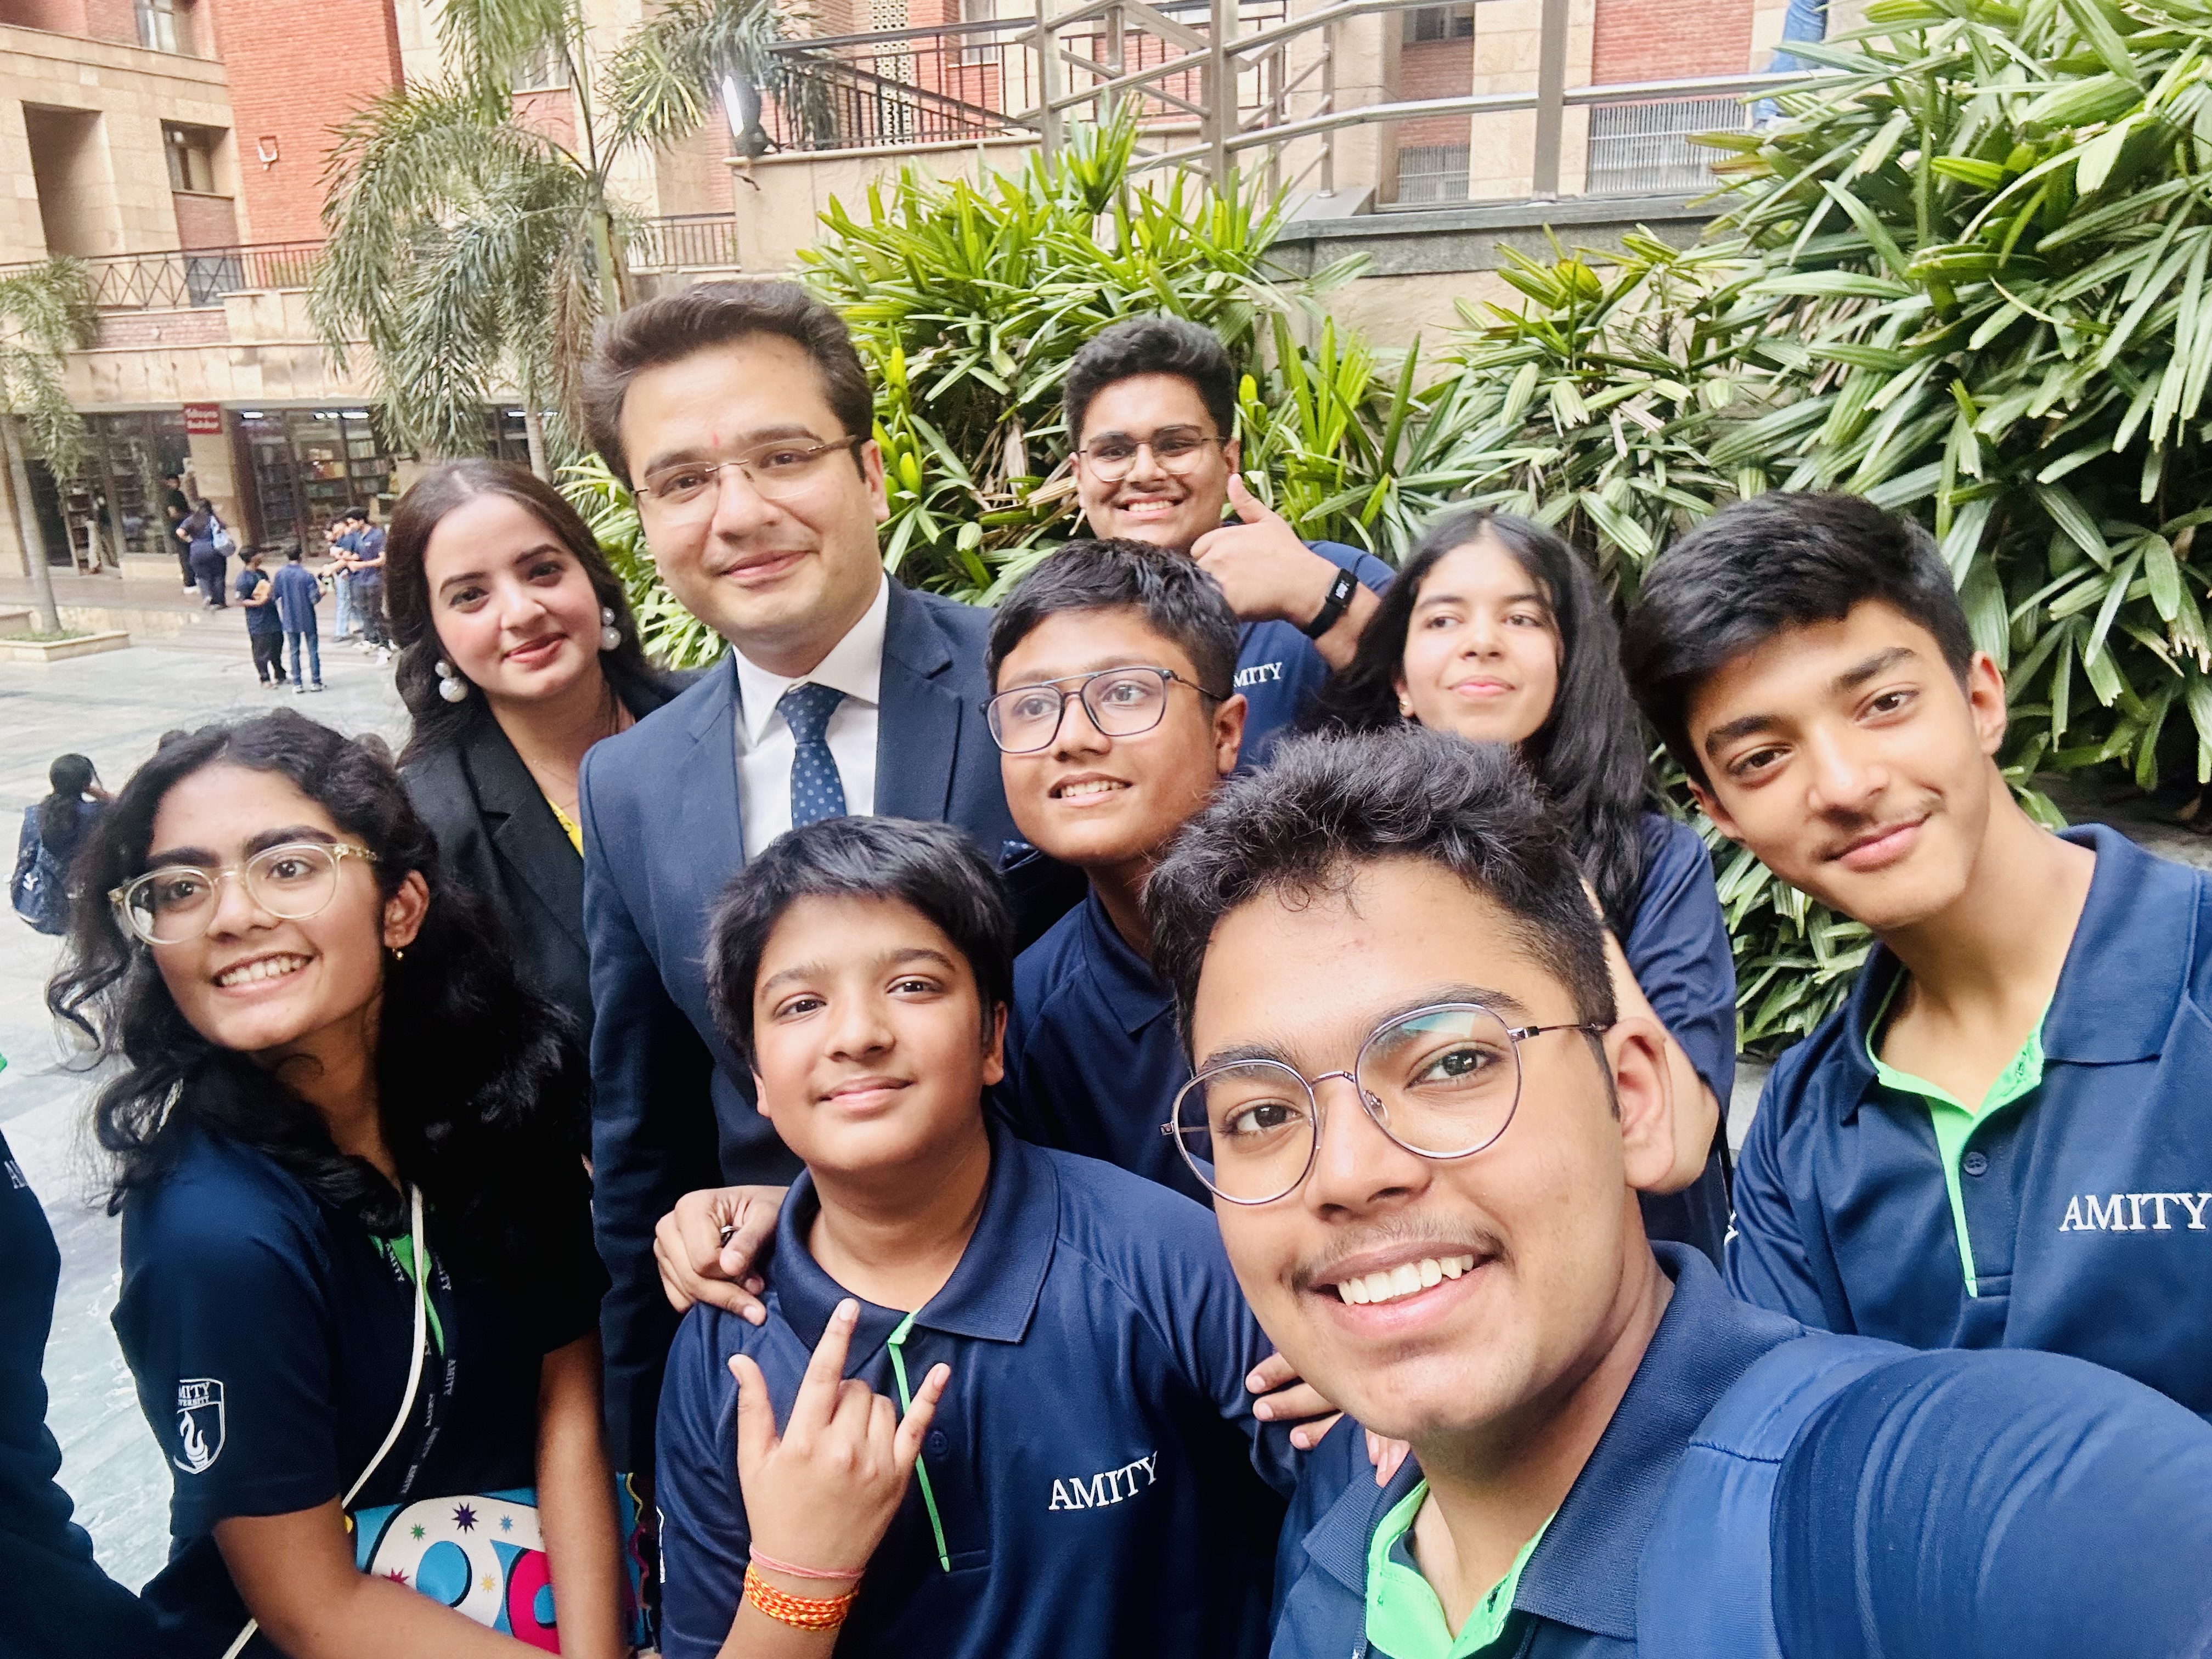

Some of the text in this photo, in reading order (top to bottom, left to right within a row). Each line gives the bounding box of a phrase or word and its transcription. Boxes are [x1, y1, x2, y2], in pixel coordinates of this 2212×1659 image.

[1233, 662, 1283, 688] MITY
[2058, 1192, 2212, 1232] AMITY
[178, 1381, 211, 1398] MITY
[1048, 1450, 1158, 1510] AMITY
